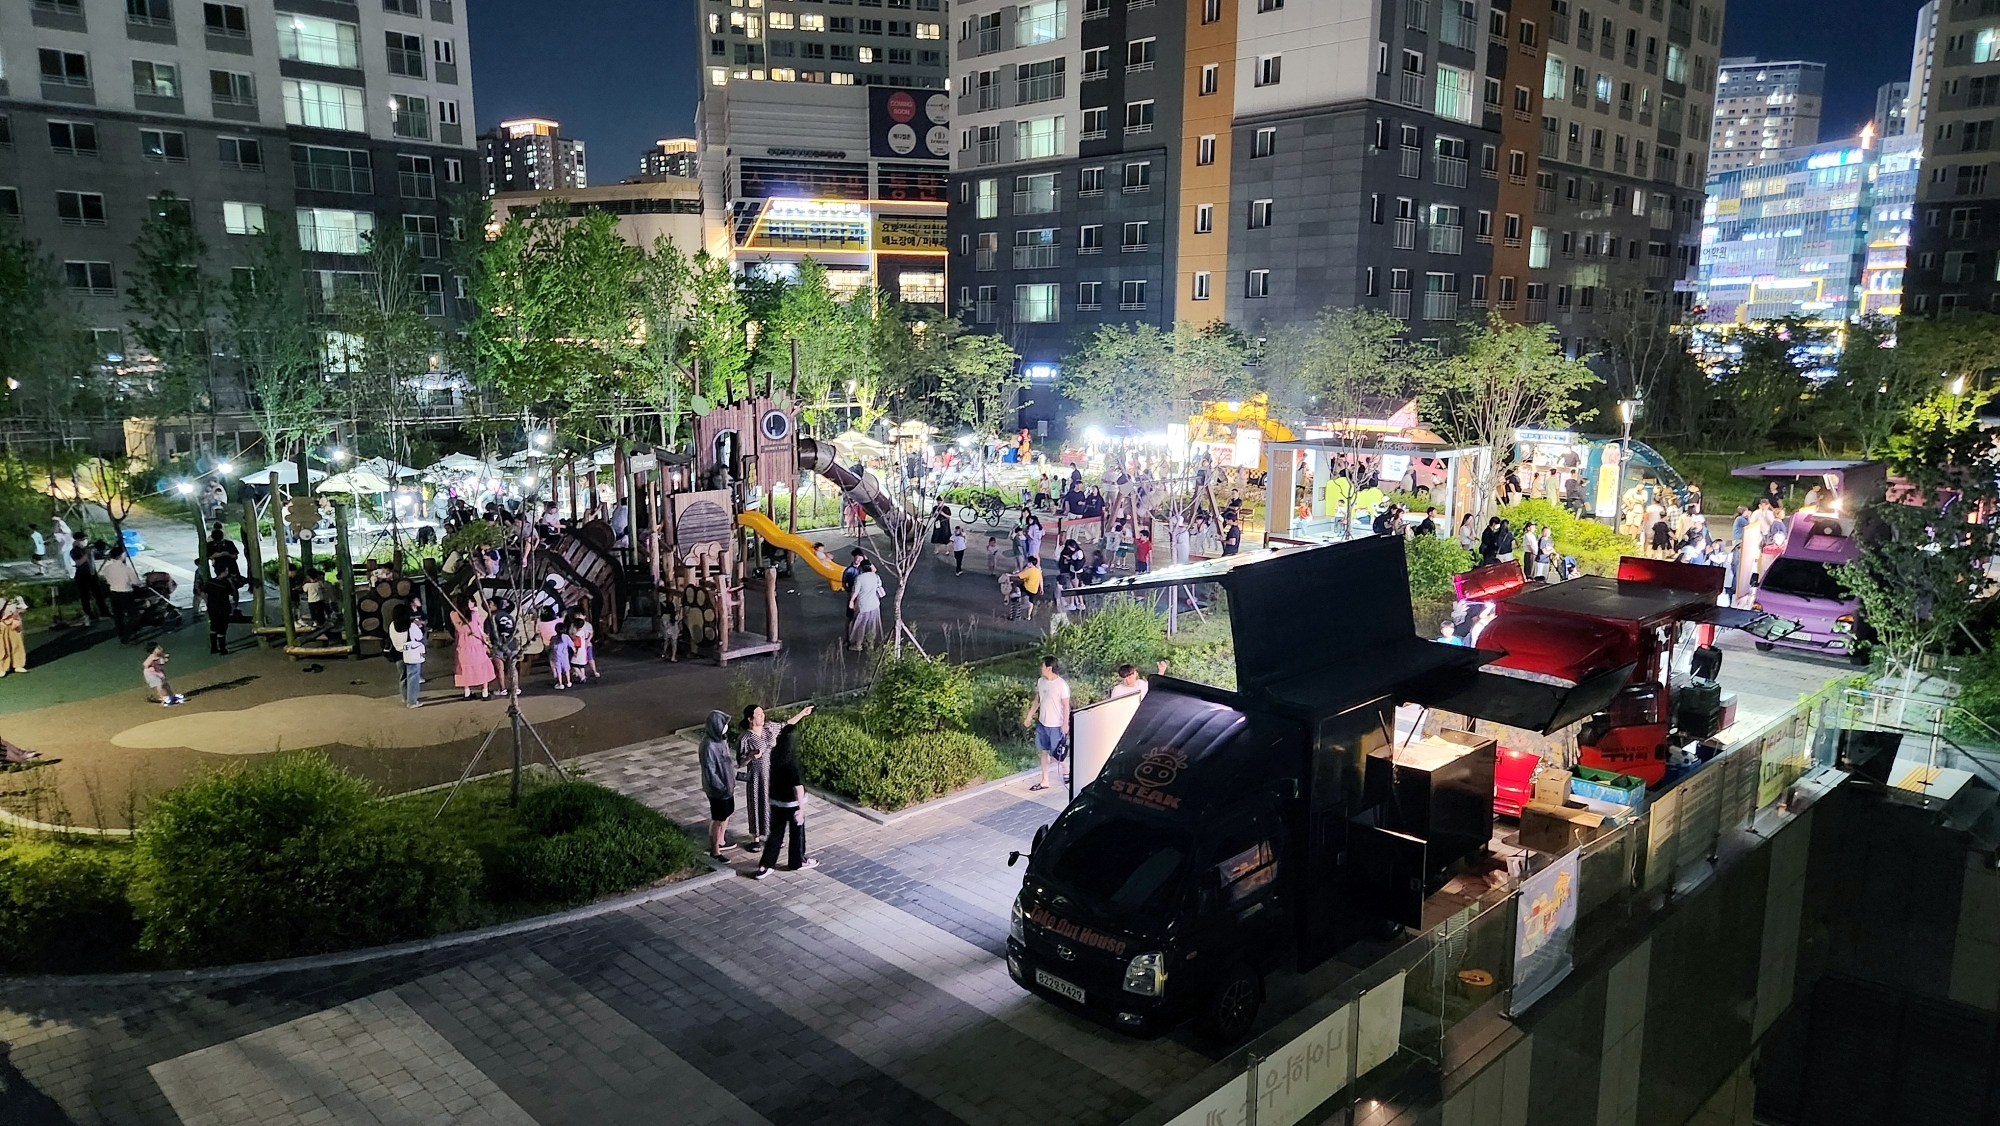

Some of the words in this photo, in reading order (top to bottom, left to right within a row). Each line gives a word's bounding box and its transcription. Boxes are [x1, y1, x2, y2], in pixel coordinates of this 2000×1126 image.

[1111, 779, 1182, 809] STEAK
[1030, 904, 1057, 933] Take
[1056, 920, 1081, 944] Out
[1081, 926, 1127, 955] House
